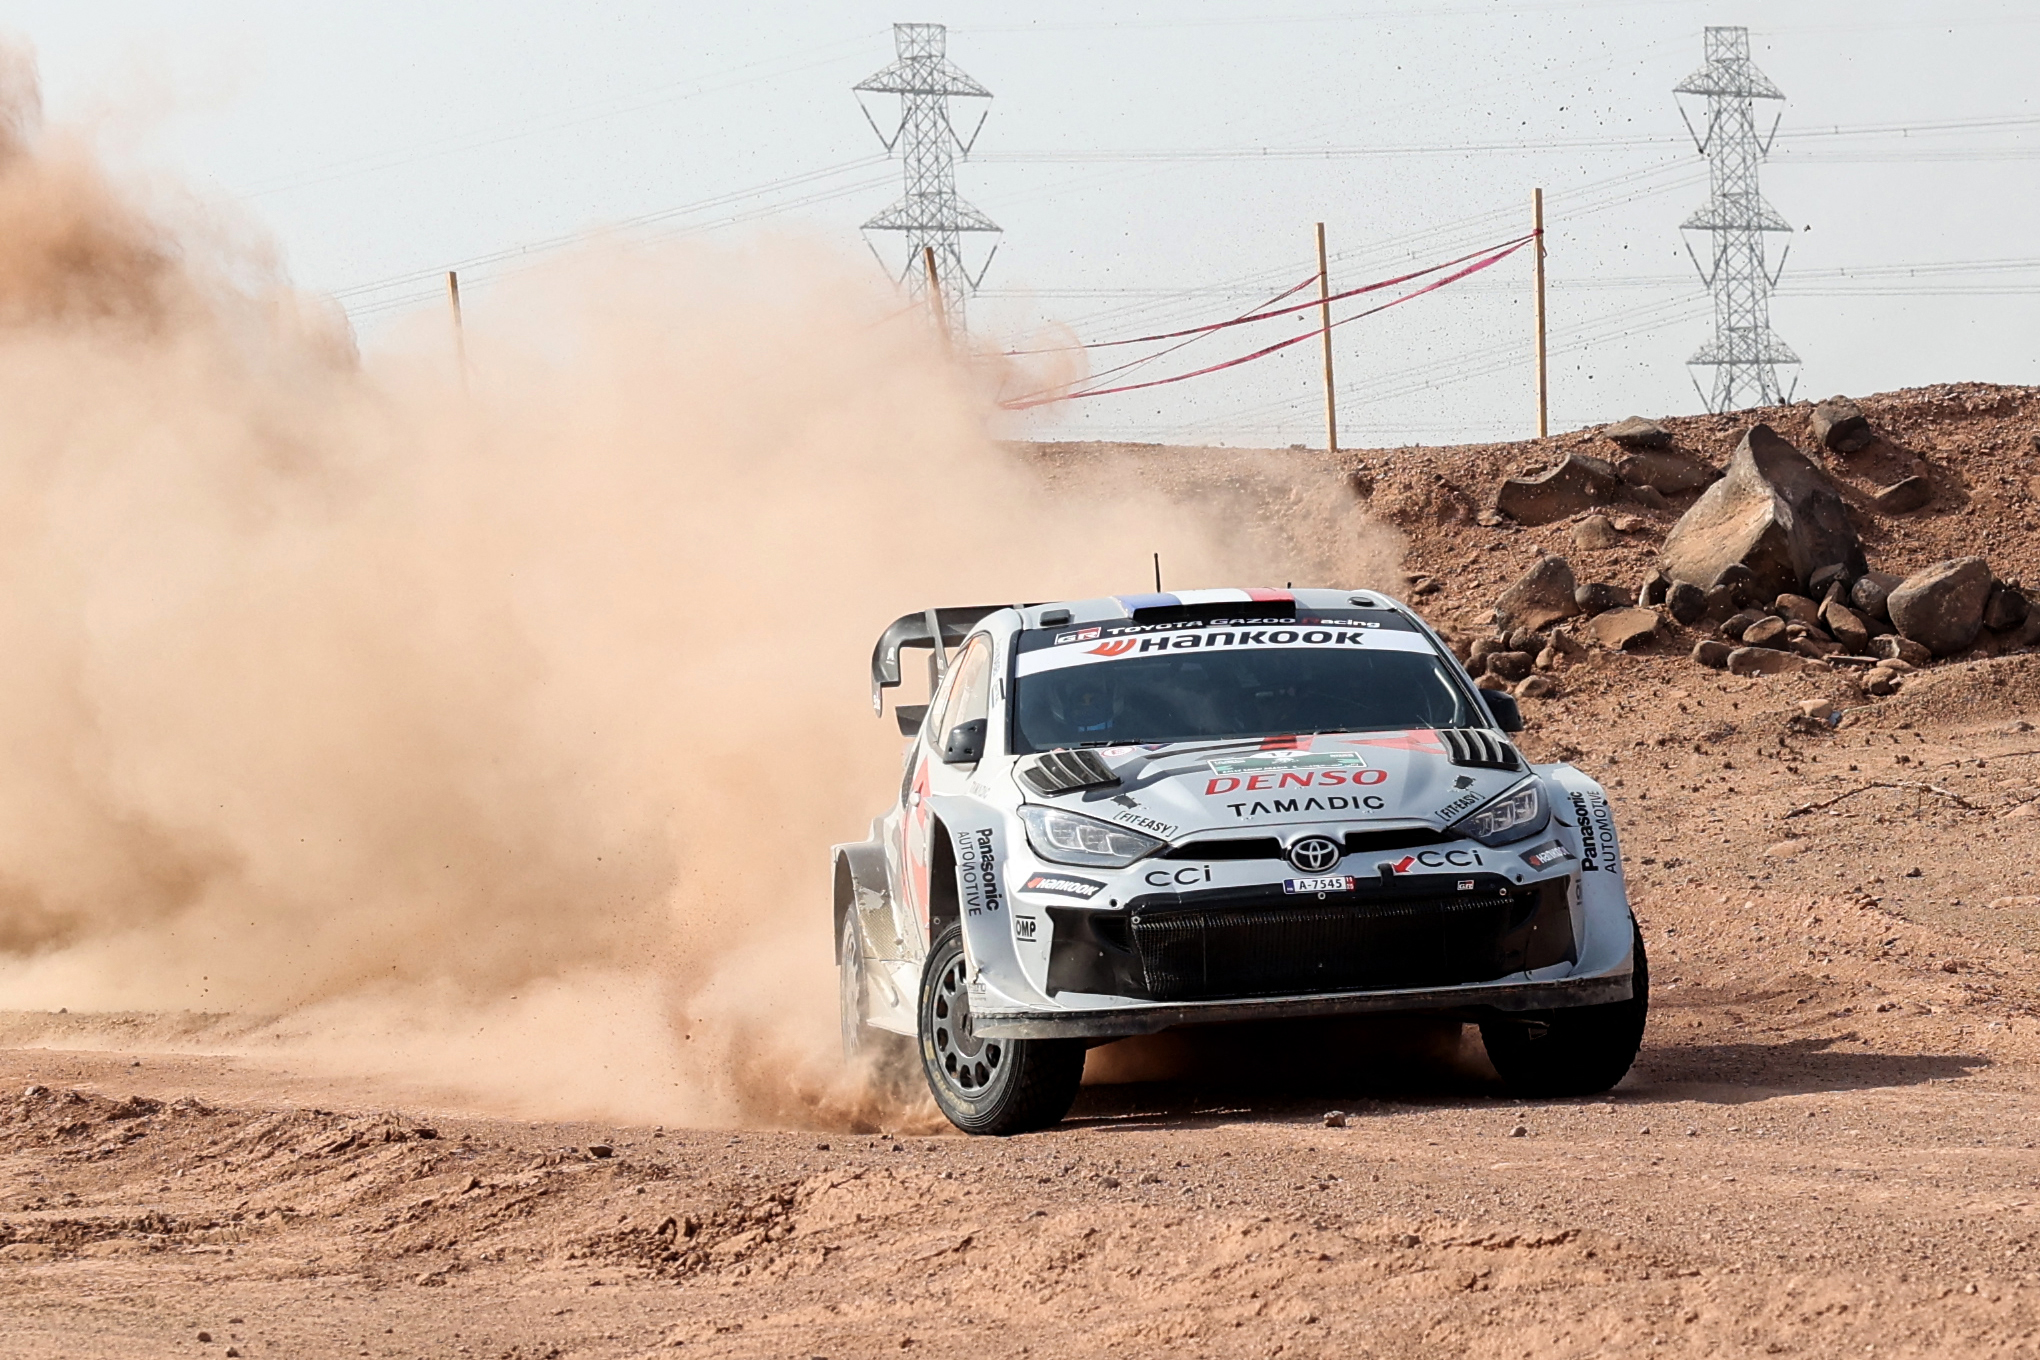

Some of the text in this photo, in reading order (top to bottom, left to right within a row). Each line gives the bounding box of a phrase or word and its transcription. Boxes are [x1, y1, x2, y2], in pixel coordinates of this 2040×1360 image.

[1107, 619, 1203, 635] TOYOTA
[1209, 617, 1296, 626] GAZOO
[1205, 769, 1388, 795] DENSO
[1227, 796, 1385, 817] TAMADIC
[1567, 791, 1599, 872] Panasonic
[1587, 791, 1617, 874] AUTOMOTIVE
[957, 831, 982, 917] AUTOMOTIVE
[976, 828, 1003, 912] Panasonic
[1299, 879, 1342, 890] A-7545
[1015, 920, 1037, 938] OMP
